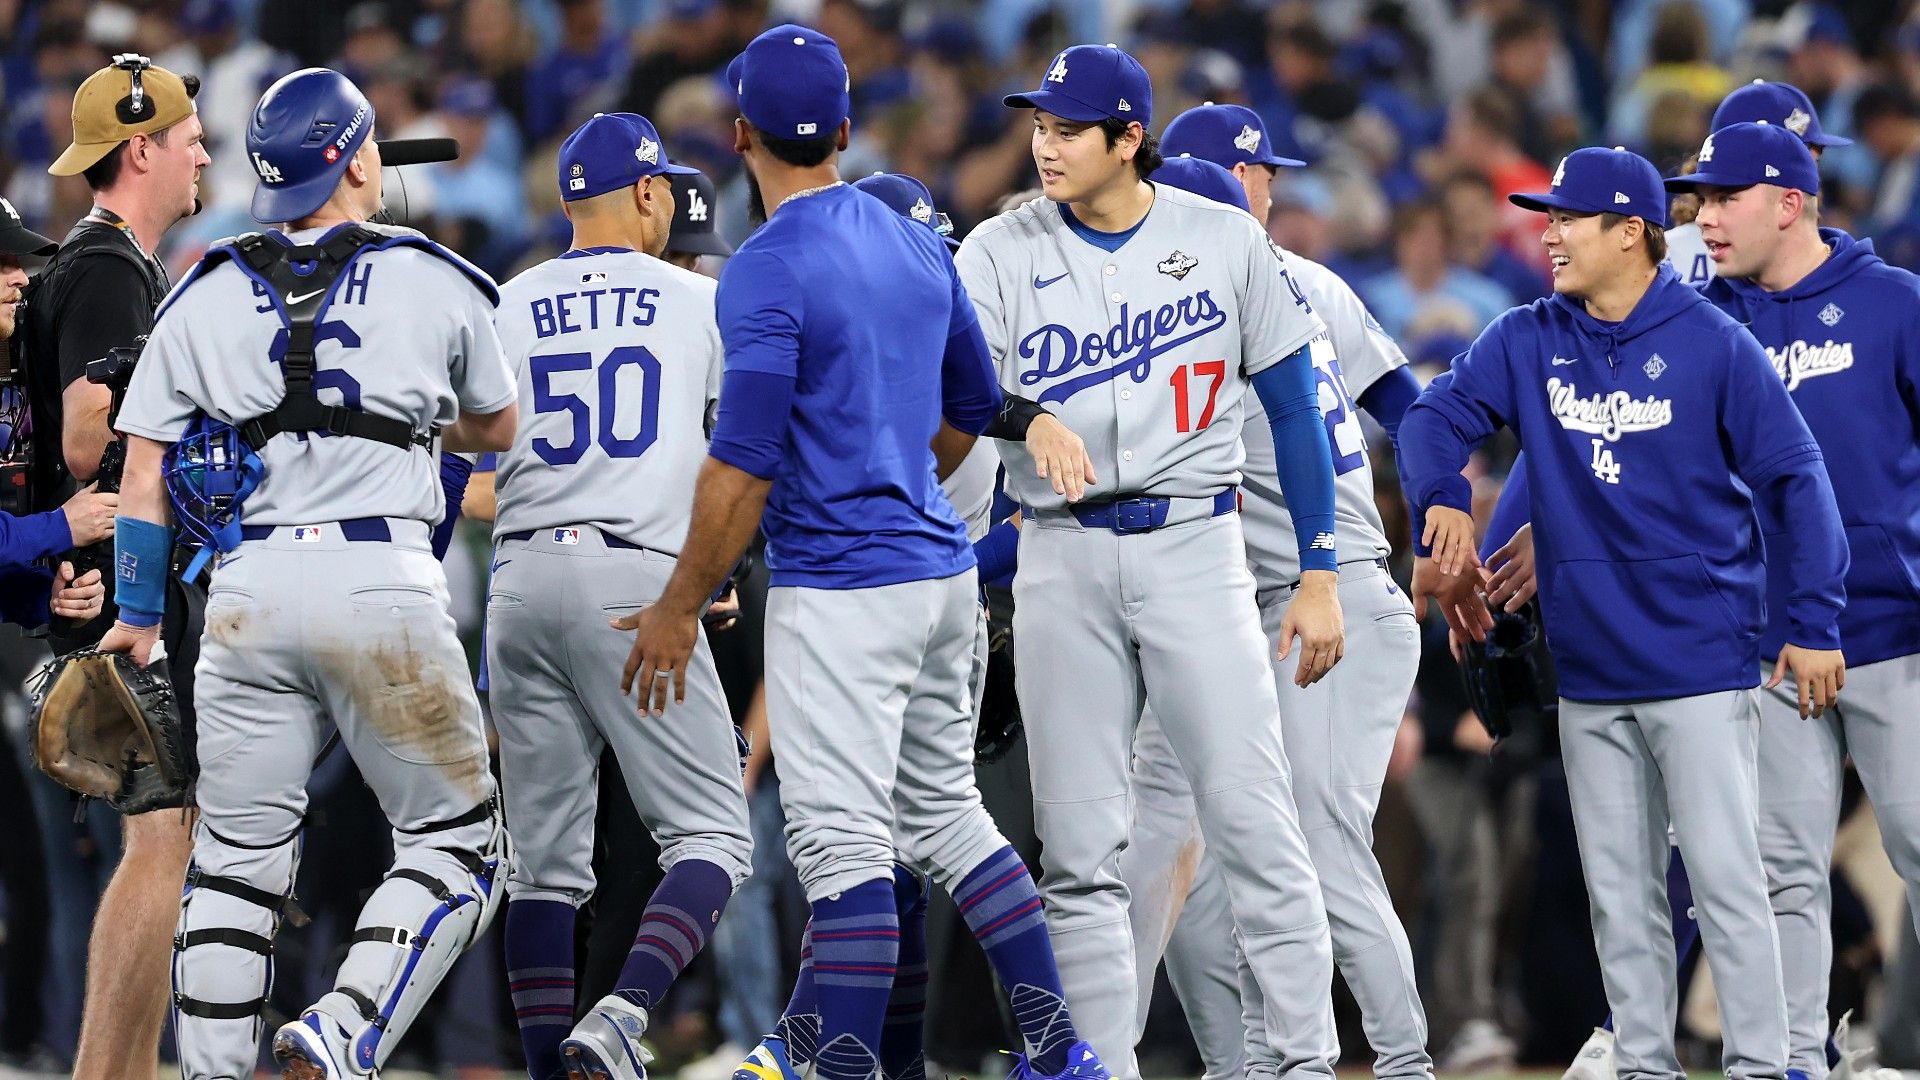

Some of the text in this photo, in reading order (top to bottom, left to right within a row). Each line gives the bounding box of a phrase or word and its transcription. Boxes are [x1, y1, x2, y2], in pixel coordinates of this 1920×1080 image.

[252, 152, 284, 183] LA
[687, 188, 708, 221] LA
[530, 287, 660, 339] BETTS
[1018, 289, 1226, 403] Dodgers
[1787, 339, 1854, 392] Series
[529, 345, 662, 466] 50
[1169, 359, 1226, 433] 17
[1547, 377, 1672, 442] World Series
[1591, 438, 1621, 484] LA
